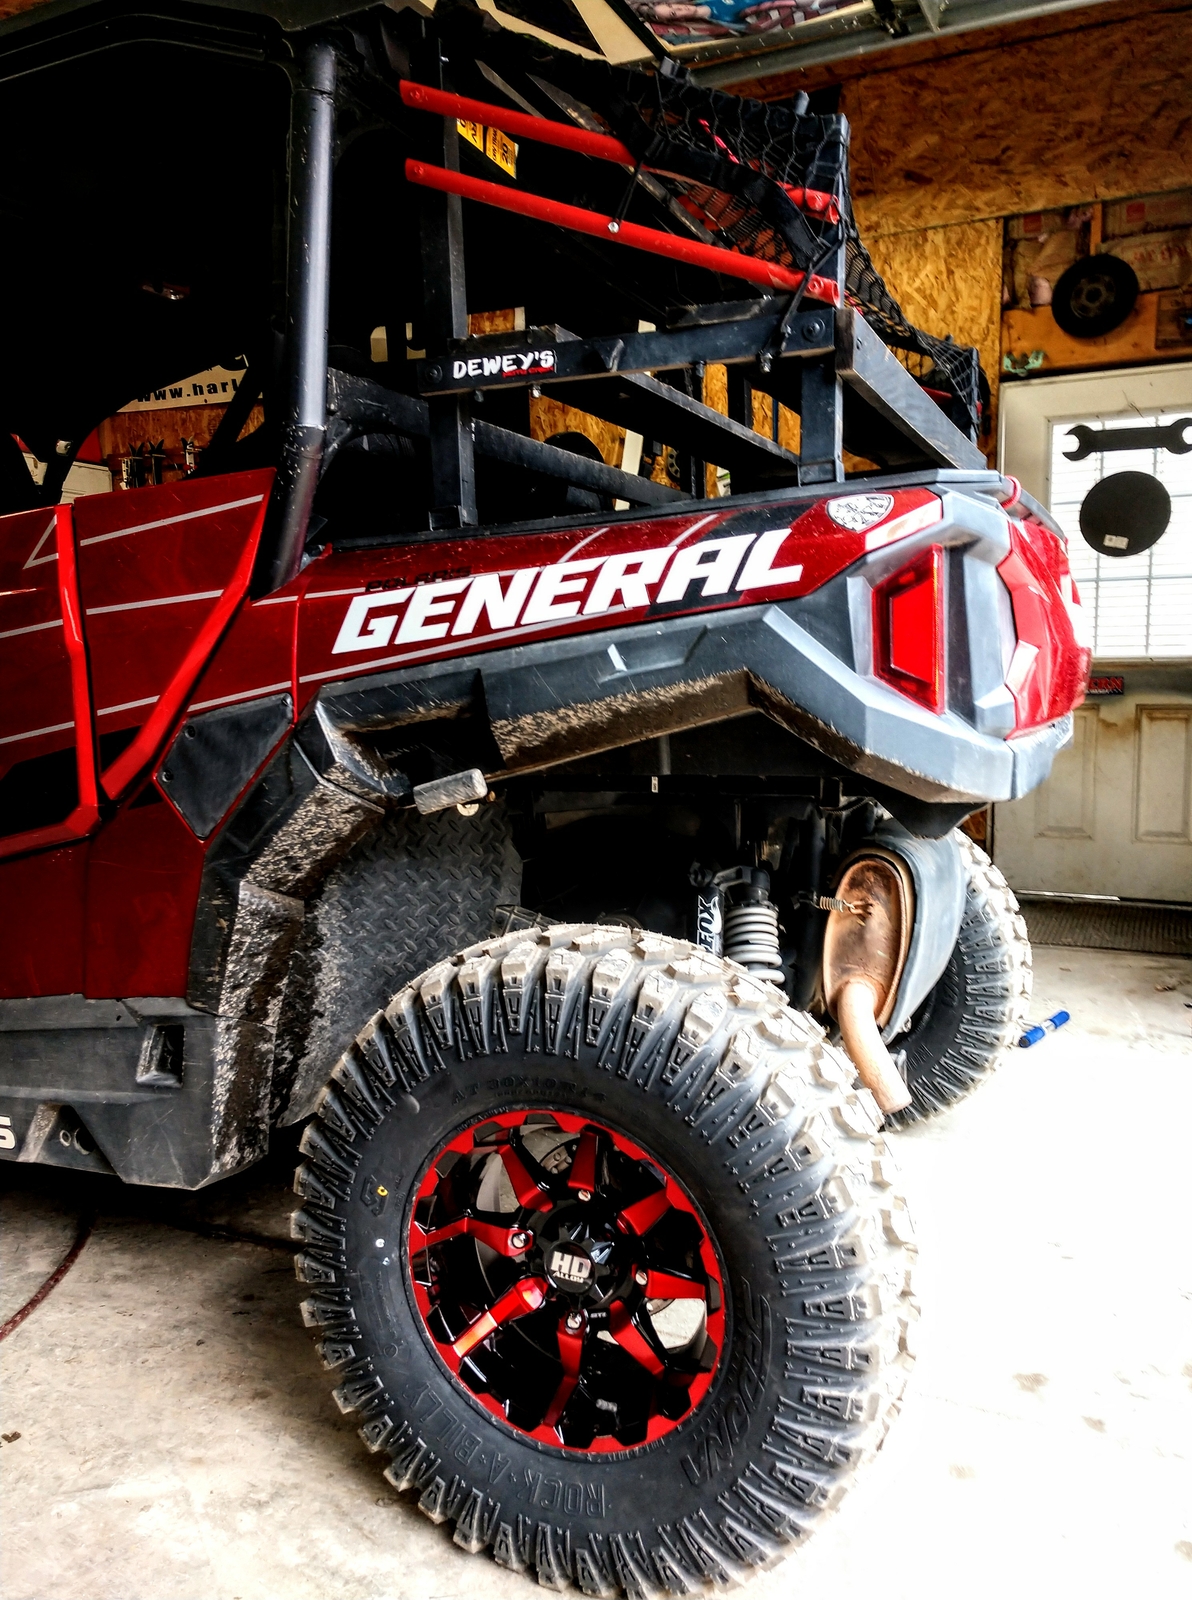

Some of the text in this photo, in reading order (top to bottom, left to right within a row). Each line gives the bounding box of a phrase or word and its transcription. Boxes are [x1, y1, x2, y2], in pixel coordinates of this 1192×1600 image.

[452, 350, 555, 380] DEWEY'S
[331, 527, 804, 654] GENERAL
[365, 564, 473, 592] POLARIS
[697, 895, 722, 955] FOX
[550, 1250, 592, 1279] HD
[517, 1467, 607, 1519] ROCK
